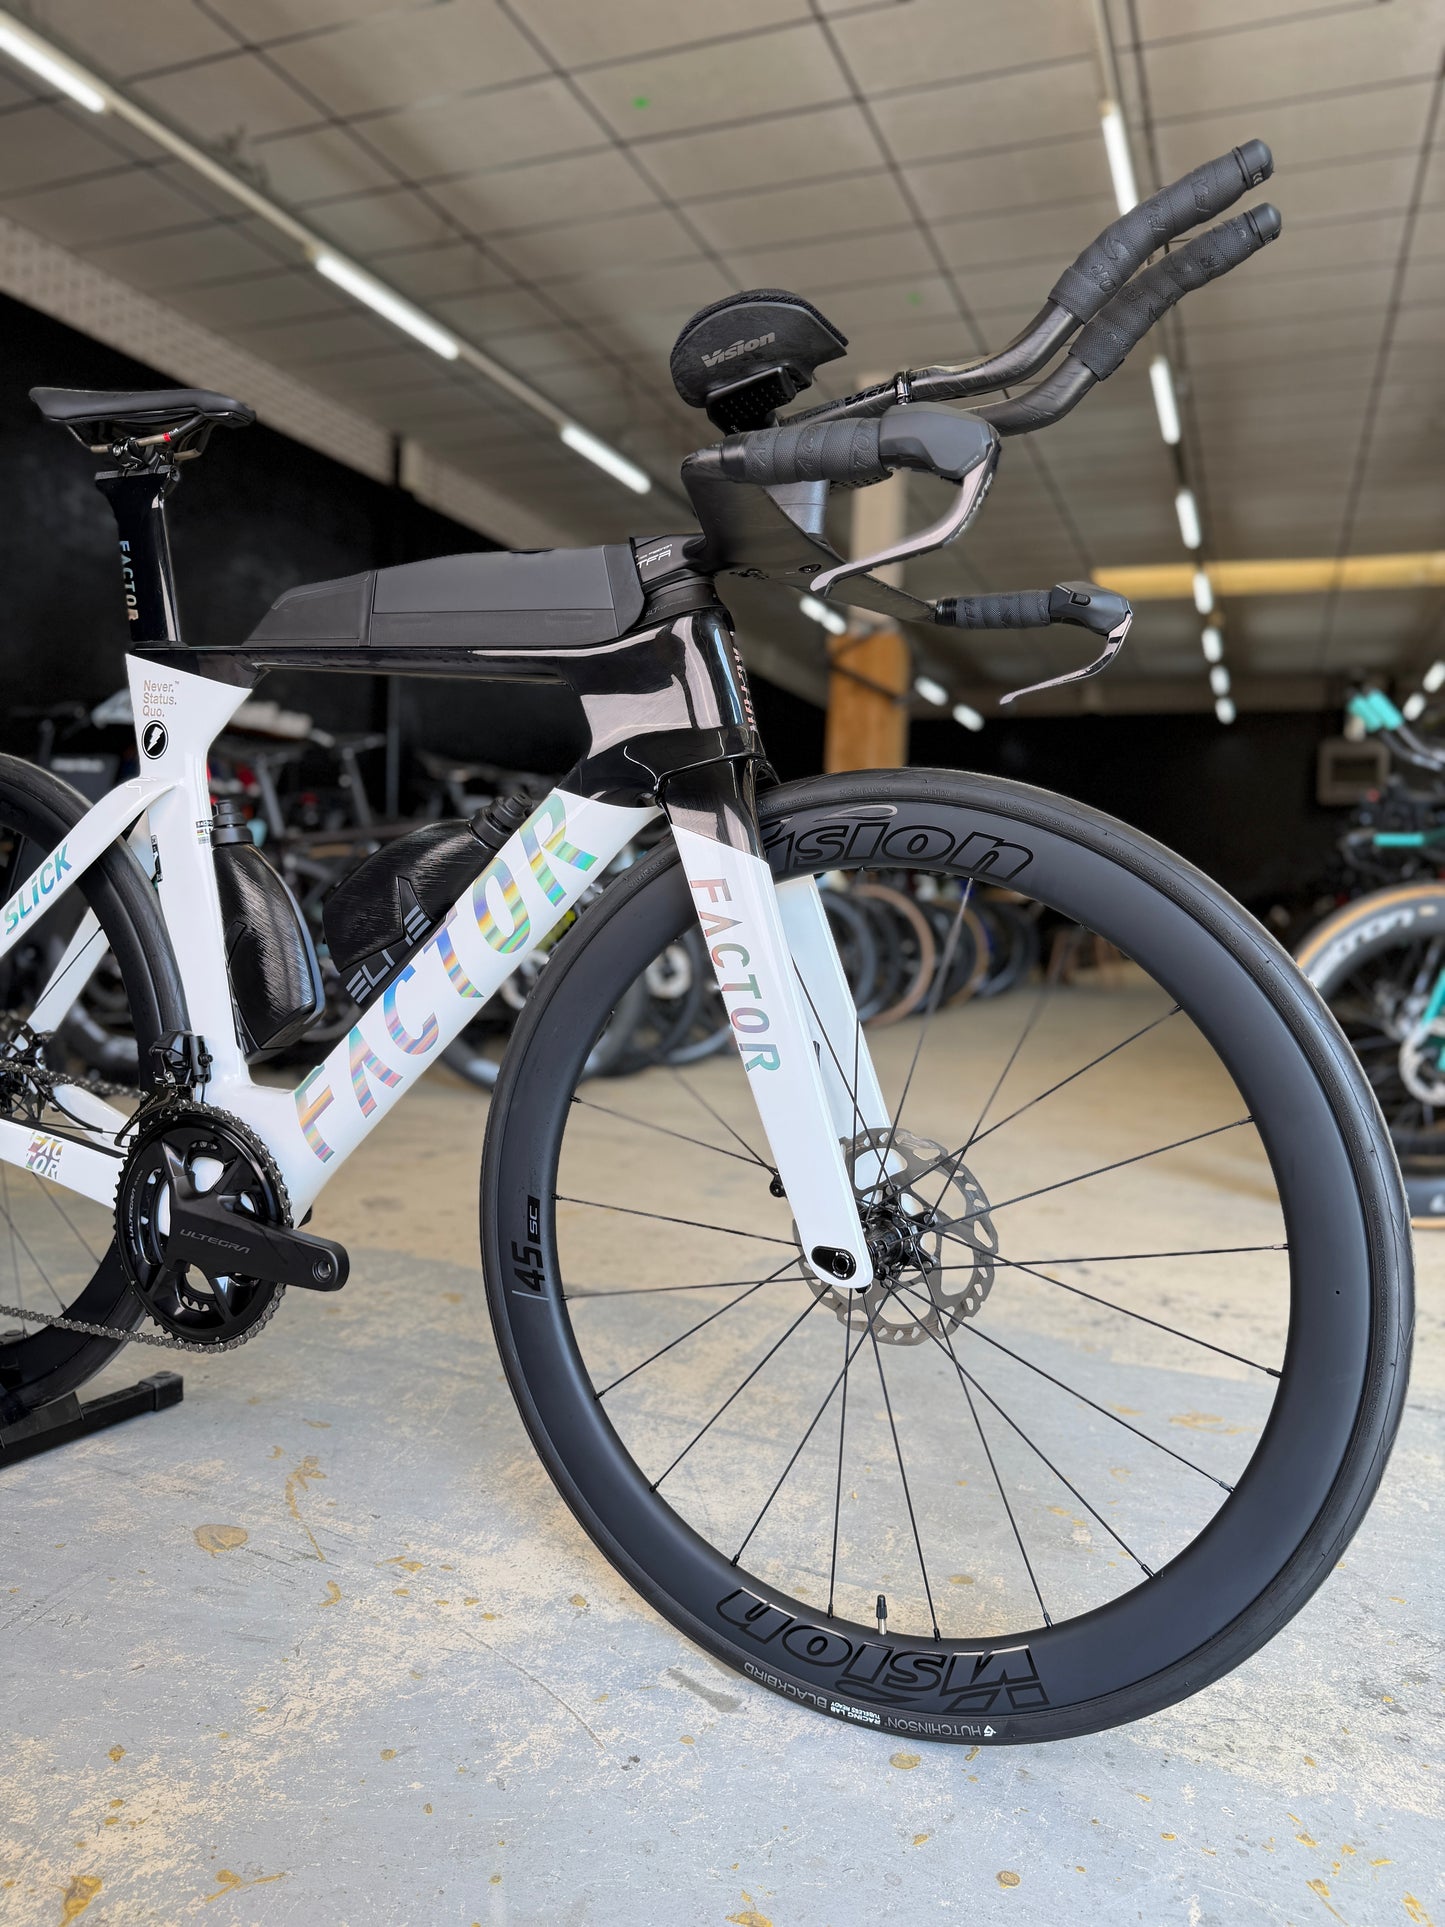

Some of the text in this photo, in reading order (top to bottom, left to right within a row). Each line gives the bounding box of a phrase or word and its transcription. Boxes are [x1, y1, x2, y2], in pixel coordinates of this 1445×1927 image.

[701, 331, 776, 368] Vision
[119, 540, 139, 621] FACTOR
[142, 705, 165, 718] Quo.
[143, 692, 177, 705] Status.
[760, 804, 1034, 882] ision
[294, 793, 599, 1163] FACTOR
[690, 878, 781, 1073] FACTOR
[529, 1204, 538, 1235] SC
[179, 1228, 251, 1254] ULTEGRA
[715, 1586, 1050, 1713] Vision
[743, 1661, 828, 1709] BLACKBIRD
[830, 1701, 880, 1720] TUBELESS READY
[830, 1706, 881, 1725] RACING LAB
